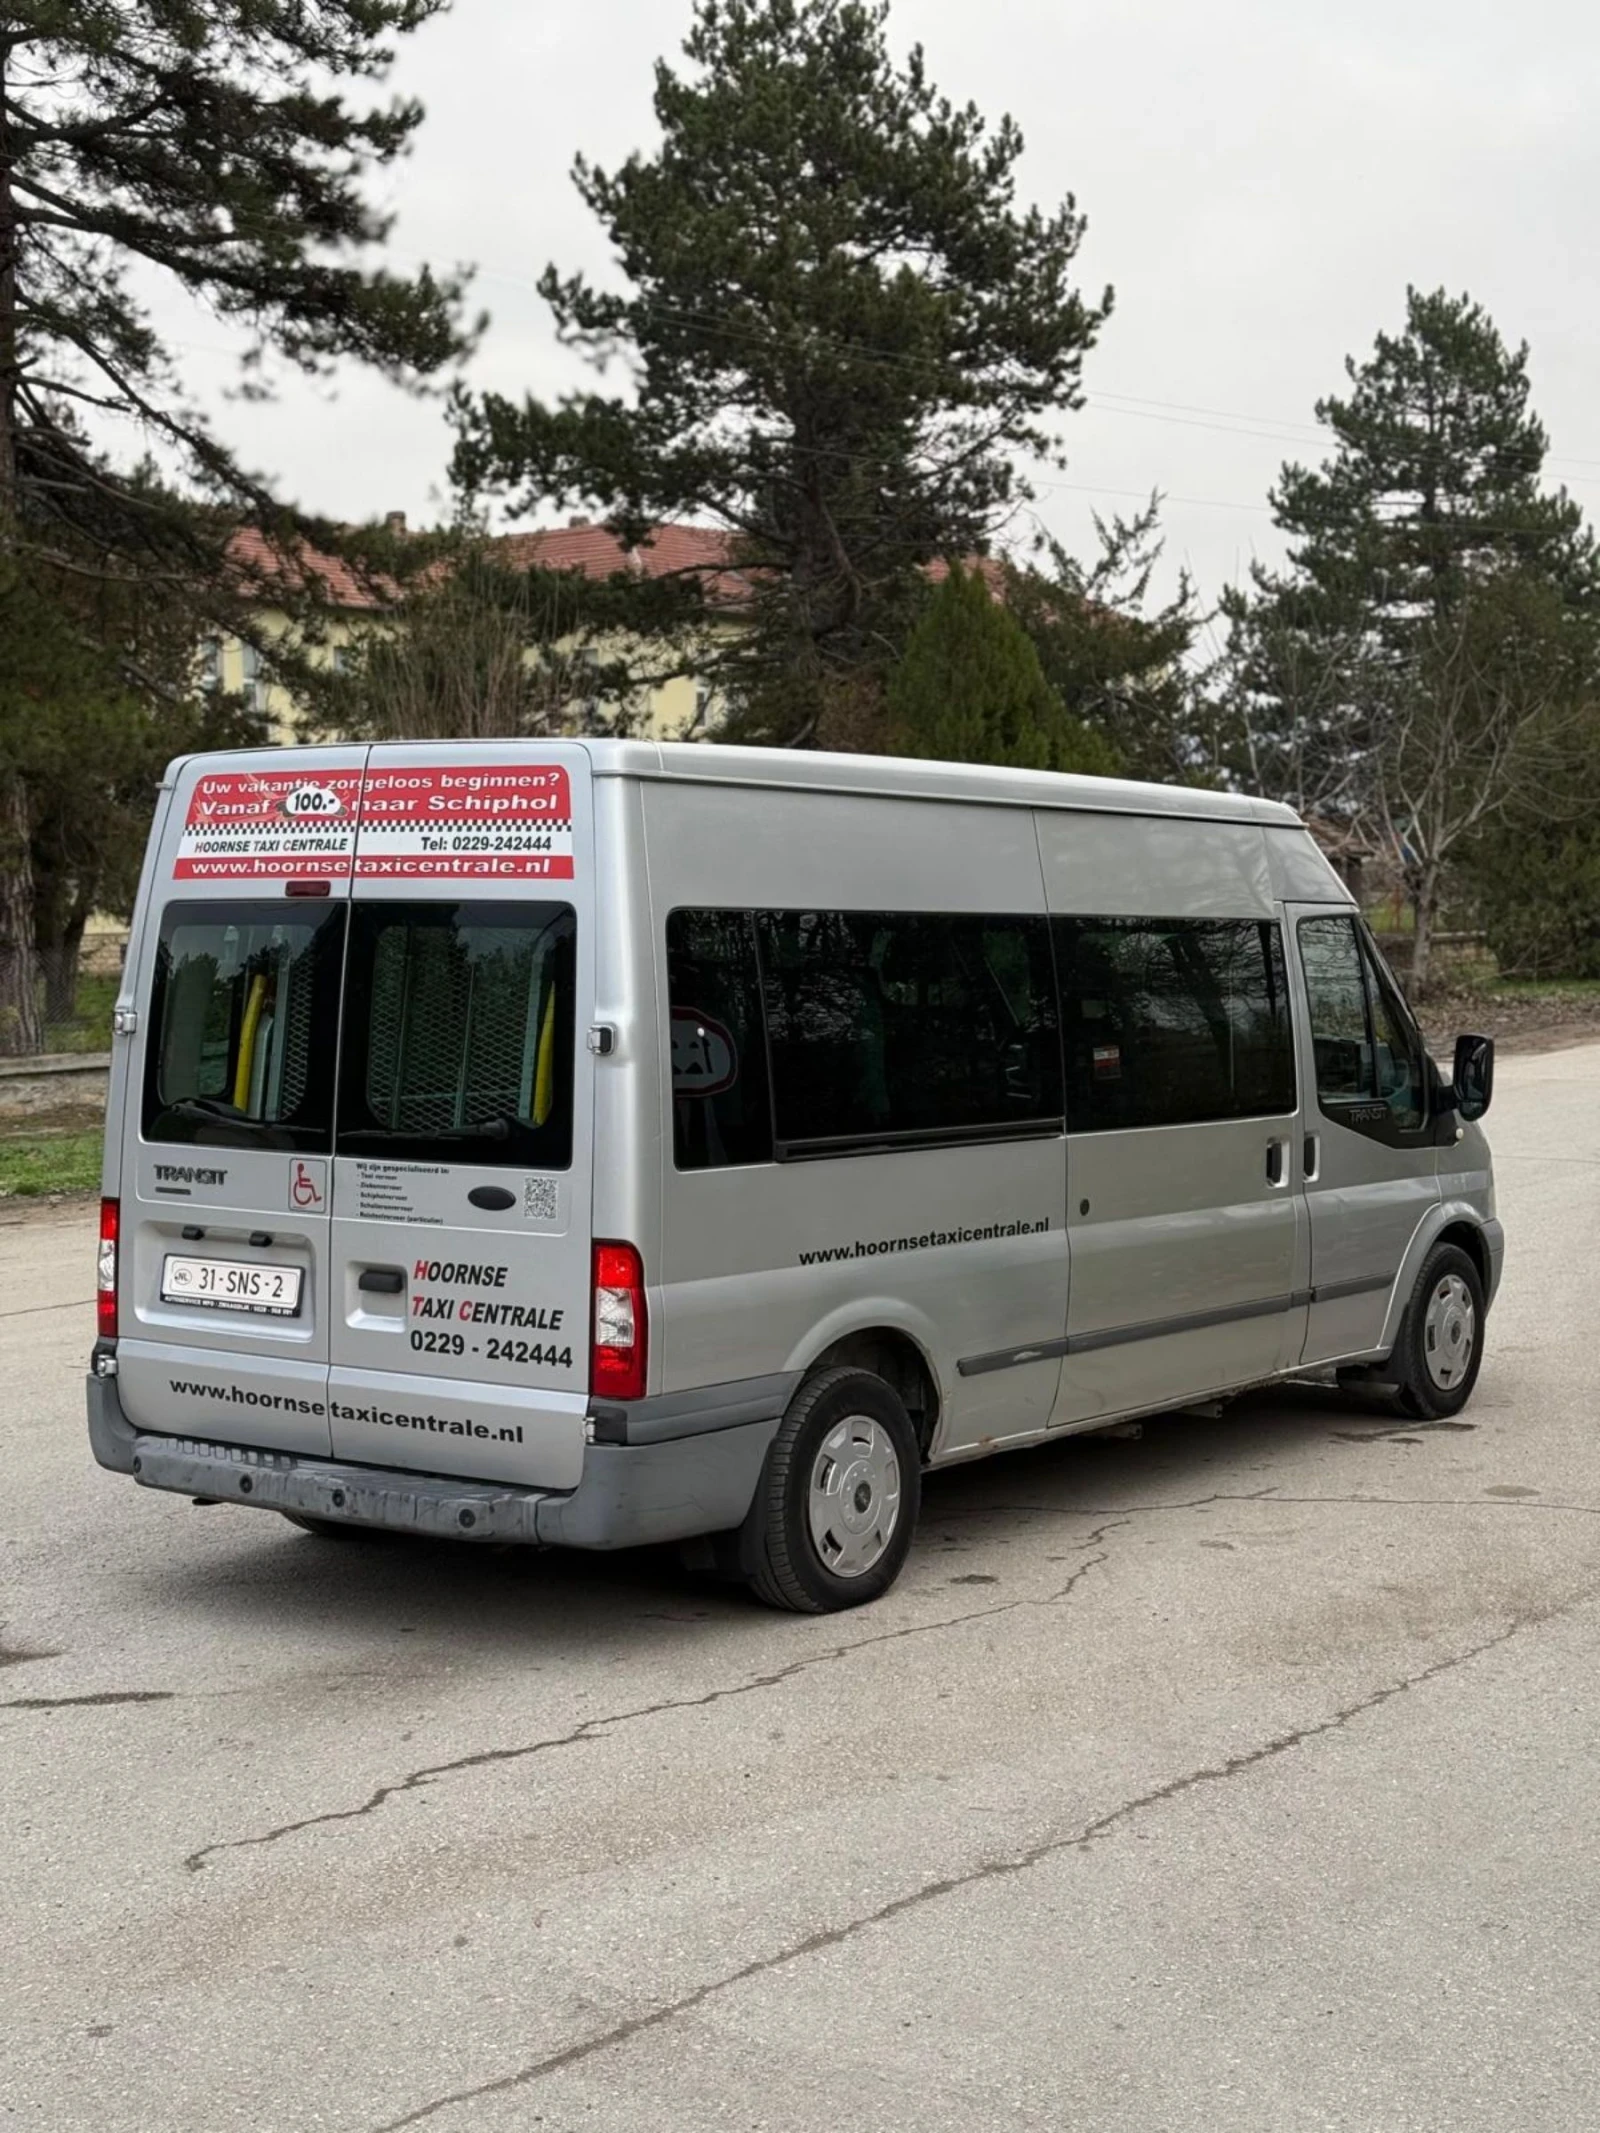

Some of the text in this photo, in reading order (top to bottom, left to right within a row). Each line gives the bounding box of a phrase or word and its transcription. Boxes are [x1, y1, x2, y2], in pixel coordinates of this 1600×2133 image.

[202, 781, 232, 795] Uw
[326, 775, 433, 793] zorgeloos
[440, 772, 560, 791] beginnen?
[202, 800, 271, 816] Vanaf
[427, 794, 558, 813] Schiphol
[194, 838, 348, 853] HOORNSE TAXI CENTRALE
[420, 836, 552, 851] Tel: 0229-242444
[191, 857, 550, 874] www.hoornsetaxicentrale.nl
[153, 1164, 229, 1186] TRANSIT
[799, 1217, 1050, 1266] www.hoornsetaxicentrale.nl
[413, 1260, 508, 1287] HOORNSE
[411, 1296, 564, 1331] TAXI CENTRALE
[410, 1329, 465, 1356] 0229
[486, 1337, 573, 1368] 242444
[169, 1379, 523, 1443] www.hoornsetaxicentrale.nl
